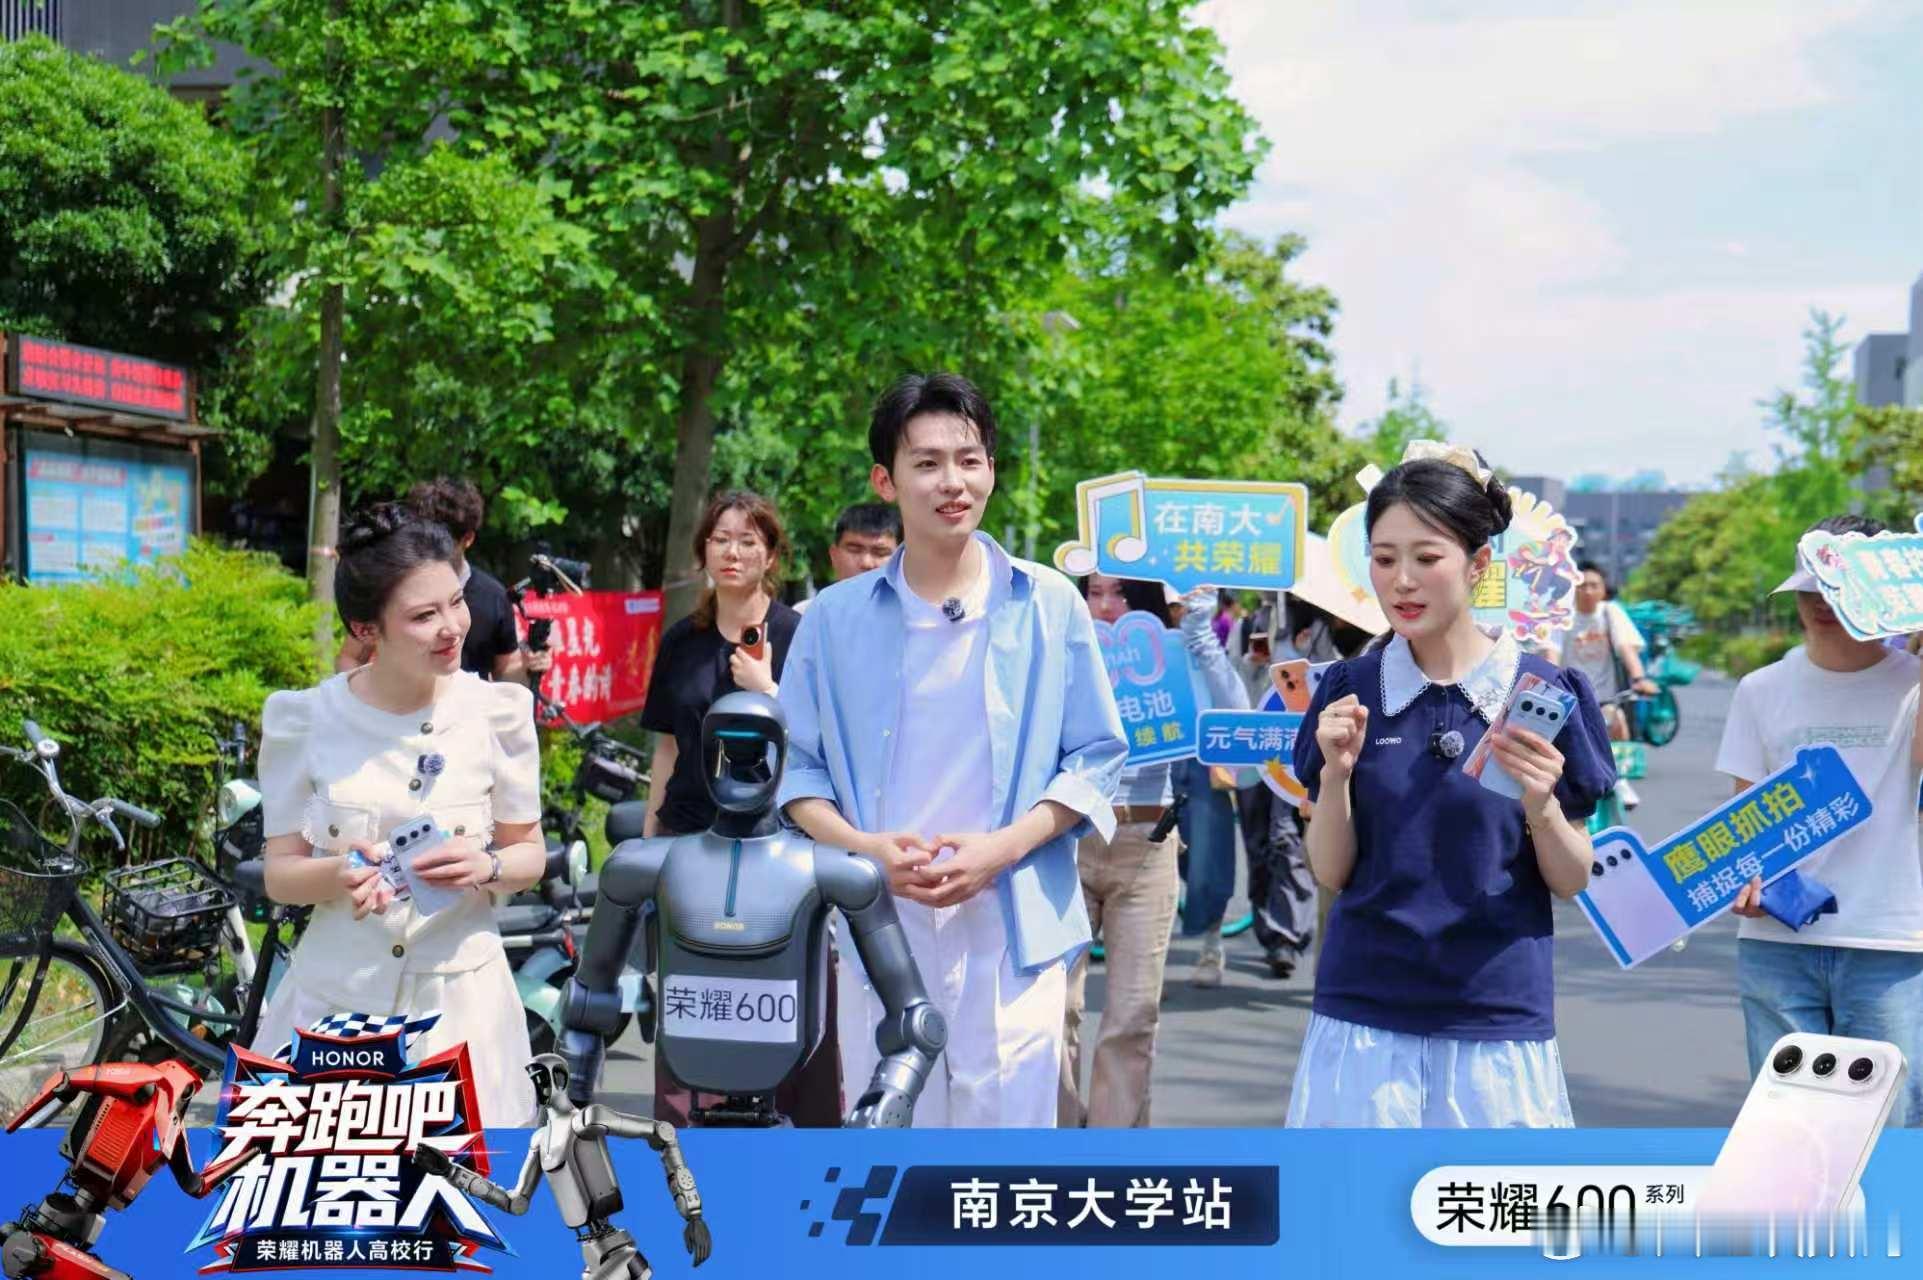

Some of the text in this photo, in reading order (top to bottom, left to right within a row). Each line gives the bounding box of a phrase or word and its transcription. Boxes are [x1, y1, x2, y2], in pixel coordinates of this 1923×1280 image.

[1153, 502, 1262, 536] 在南大
[1118, 689, 1176, 723] 电池
[1663, 781, 1806, 885] 鹰眼抓拍
[1687, 791, 1860, 912] 捕捉每一份精彩
[665, 985, 796, 1023] 荣耀600
